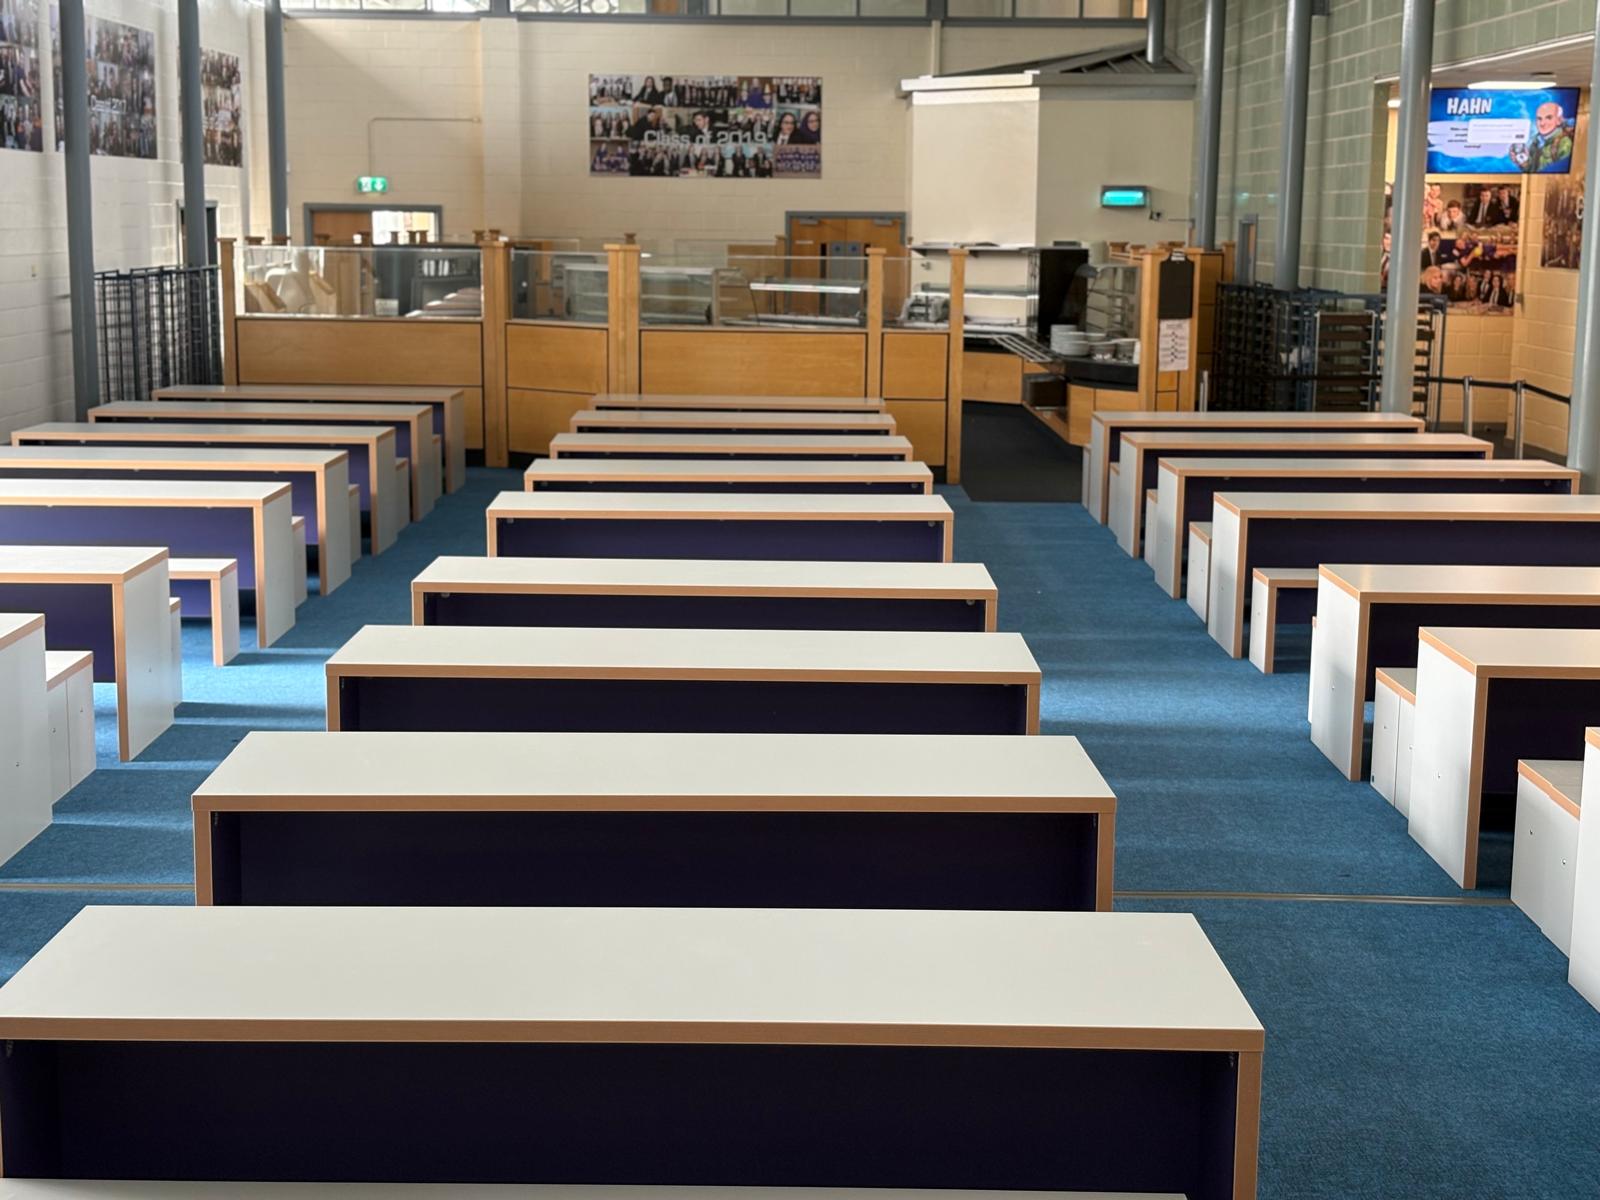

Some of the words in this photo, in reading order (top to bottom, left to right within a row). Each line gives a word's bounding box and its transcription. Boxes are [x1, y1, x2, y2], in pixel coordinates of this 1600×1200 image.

[1447, 97, 1492, 115] HAHN
[644, 129, 691, 145] Class
[695, 130, 712, 145] of
